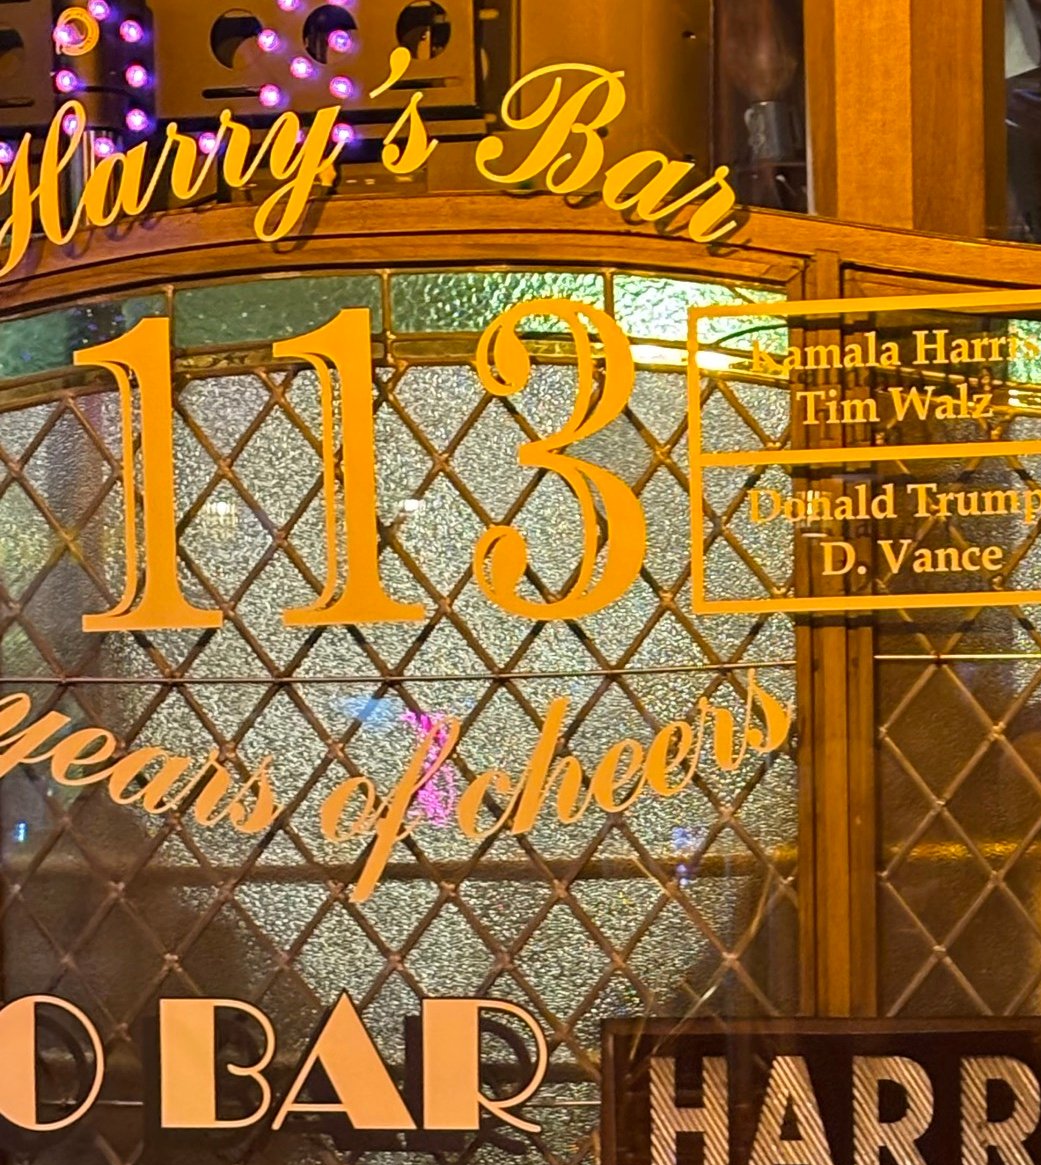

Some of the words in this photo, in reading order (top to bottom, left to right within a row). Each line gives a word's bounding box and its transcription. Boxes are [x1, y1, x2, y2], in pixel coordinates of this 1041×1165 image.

[0, 47, 438, 277] Harry's
[476, 62, 737, 244] Bar
[752, 330, 901, 371] Kamala
[912, 329, 1041, 364] Harris
[796, 389, 880, 425] Tim
[888, 383, 994, 421] Walz
[73, 299, 647, 633] 113
[746, 483, 898, 523] Donald
[819, 541, 867, 576] D.
[877, 539, 1004, 575] Vance
[0, 692, 284, 834] years
[319, 716, 460, 903] of
[457, 668, 796, 840] cheers
[159, 988, 549, 1133] BAR
